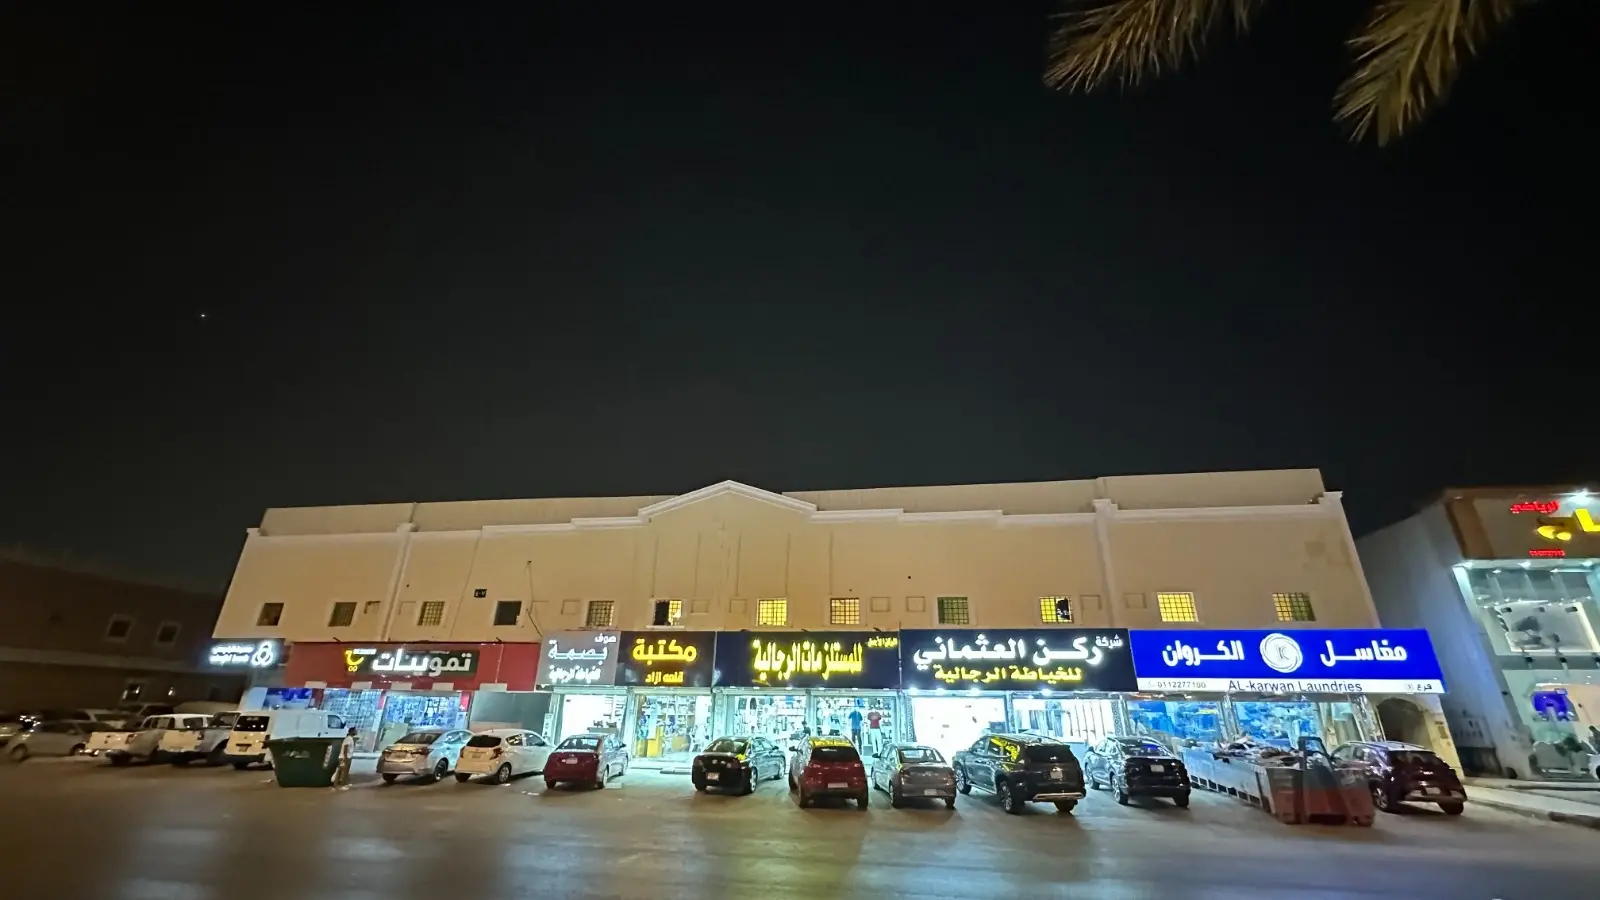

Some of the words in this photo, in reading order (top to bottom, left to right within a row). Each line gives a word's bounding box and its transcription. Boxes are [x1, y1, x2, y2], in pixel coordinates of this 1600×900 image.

[548, 639, 608, 665] بصمة
[632, 638, 697, 666] مكتبة
[913, 633, 1026, 670] العثماني
[1032, 636, 1104, 666] ركن
[1095, 635, 1124, 649] شركة
[1162, 640, 1245, 667] الكروان
[1319, 639, 1408, 667] مغاسل
[372, 647, 473, 676] تموينات
[752, 638, 801, 681] الرجالية
[801, 640, 863, 681] للمستلزمات
[932, 664, 1007, 684] الرجالية
[1009, 664, 1083, 684] للخياطة
[1228, 680, 1294, 692] AL-karwan
[1299, 680, 1363, 692] Laundries
